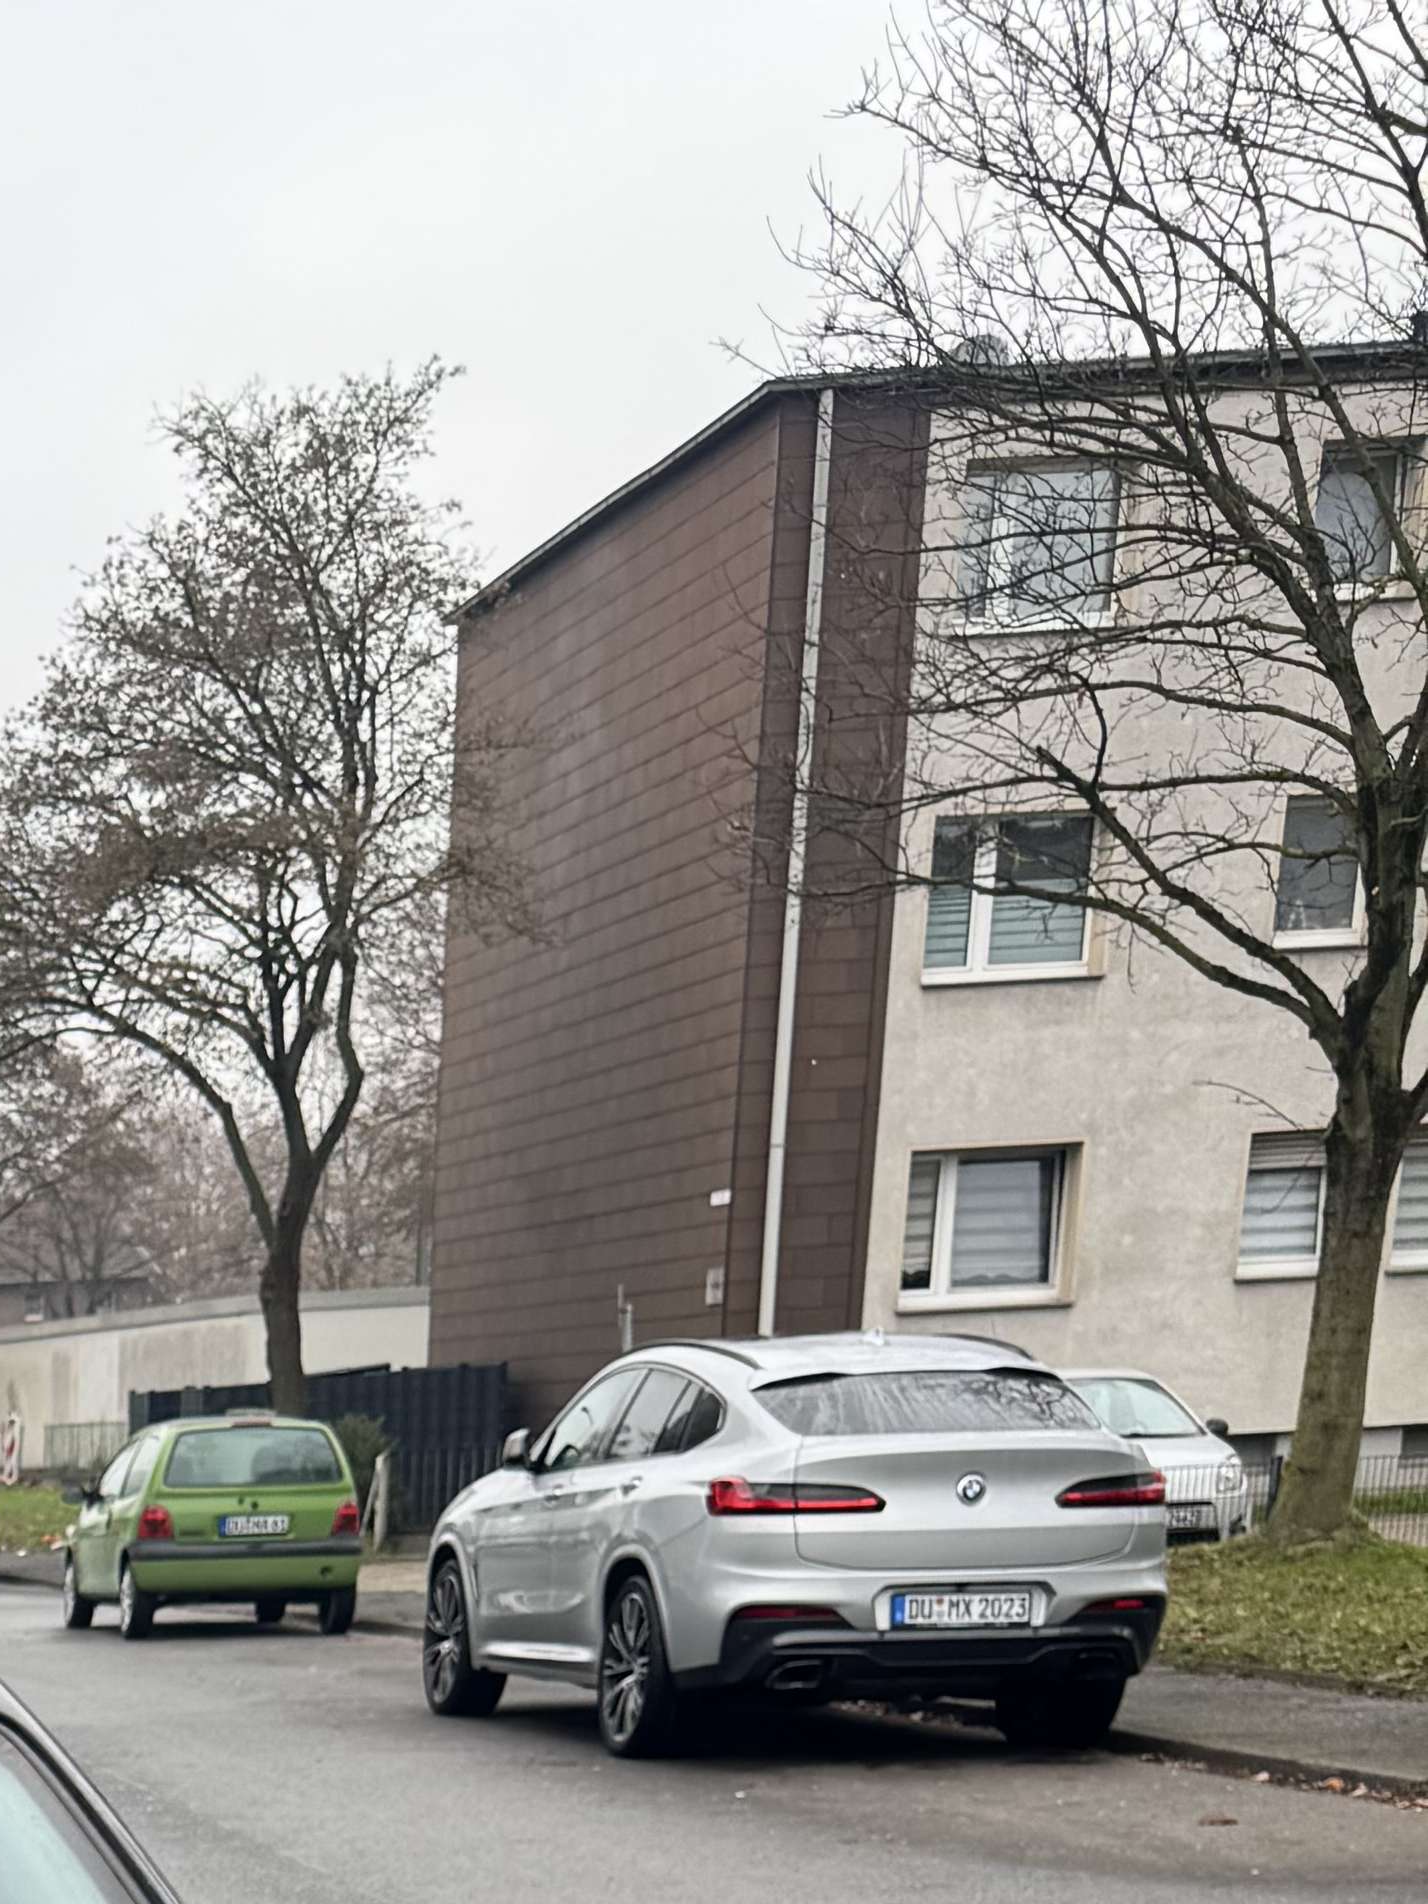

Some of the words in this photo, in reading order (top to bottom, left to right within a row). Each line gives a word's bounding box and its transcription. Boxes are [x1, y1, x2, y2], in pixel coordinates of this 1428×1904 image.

[909, 1598, 933, 1620] DU
[948, 1598, 972, 1619] MX
[978, 1597, 1027, 1619] 2023
